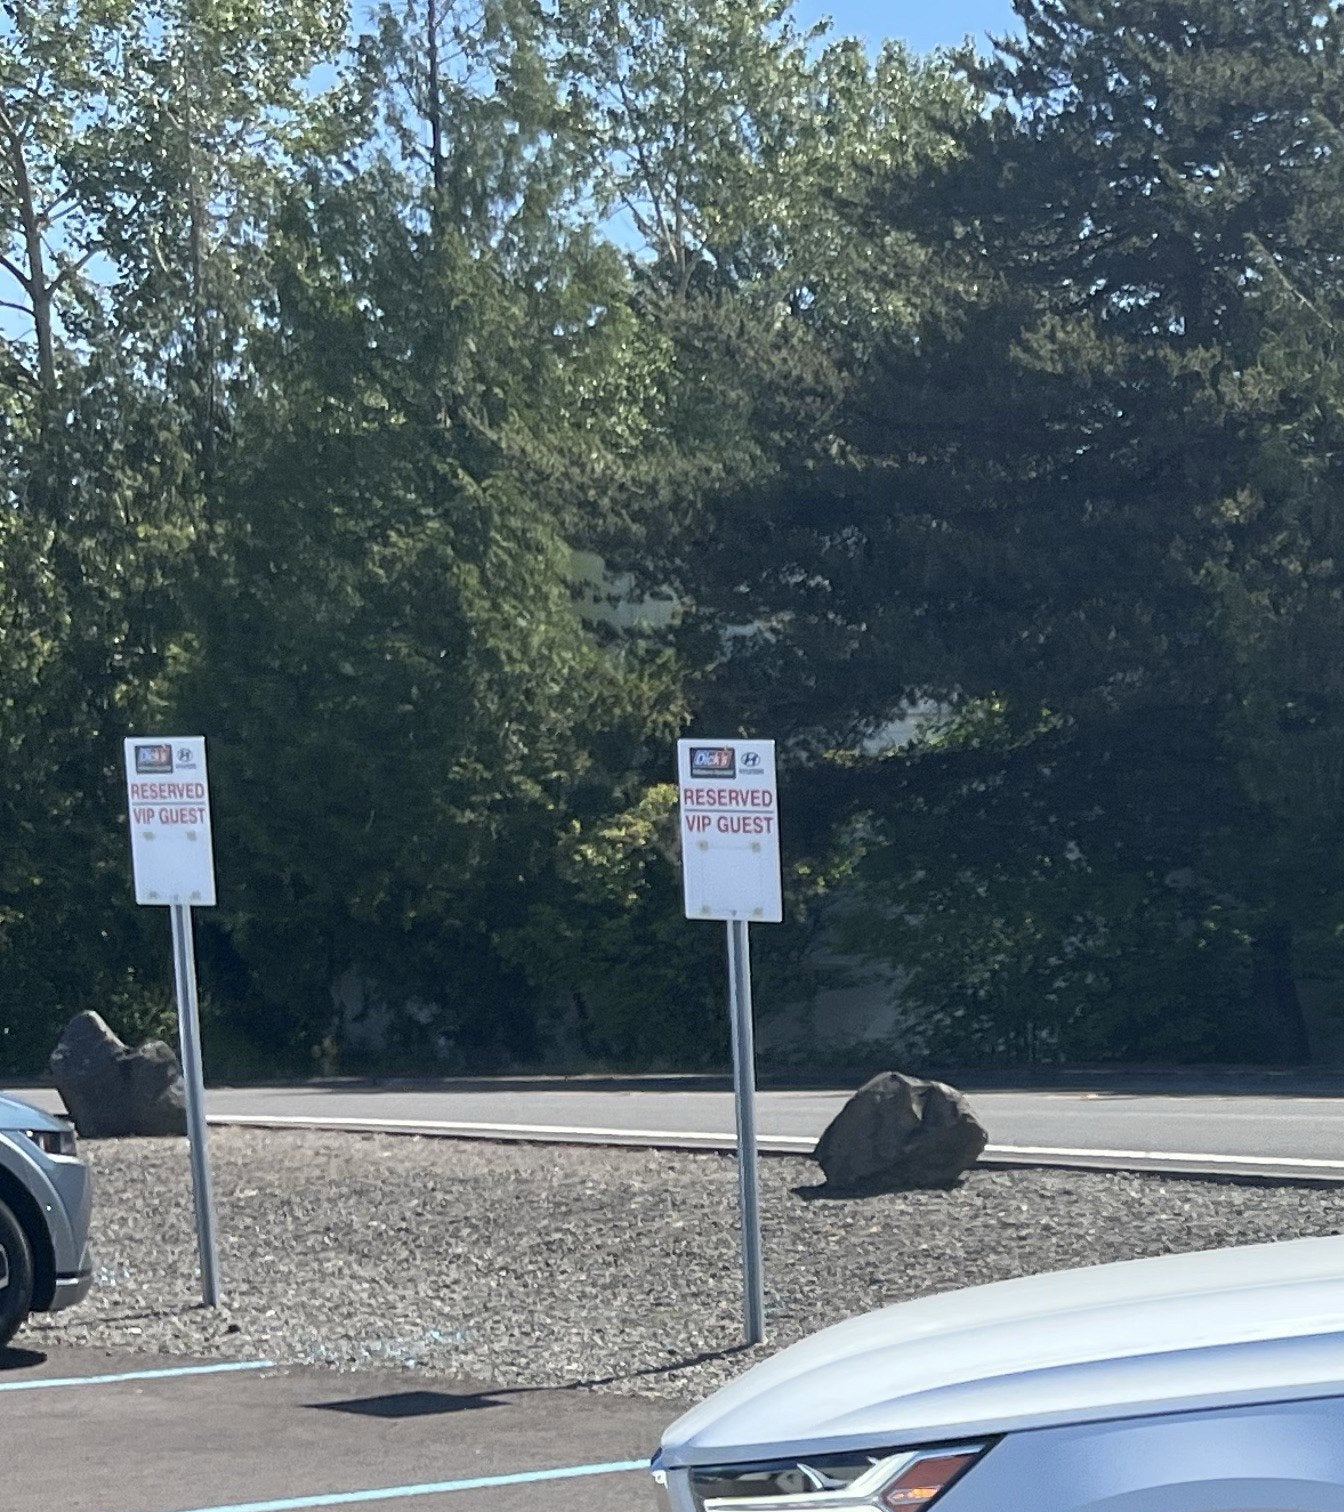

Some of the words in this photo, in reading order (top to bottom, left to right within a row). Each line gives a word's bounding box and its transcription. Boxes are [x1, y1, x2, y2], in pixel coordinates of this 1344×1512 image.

[131, 783, 205, 799] RESERVED
[684, 788, 773, 807] RESERVED
[133, 808, 155, 824] VIP
[159, 808, 206, 825] GUEST
[685, 815, 711, 832] VIP
[717, 816, 774, 834] GUEST
